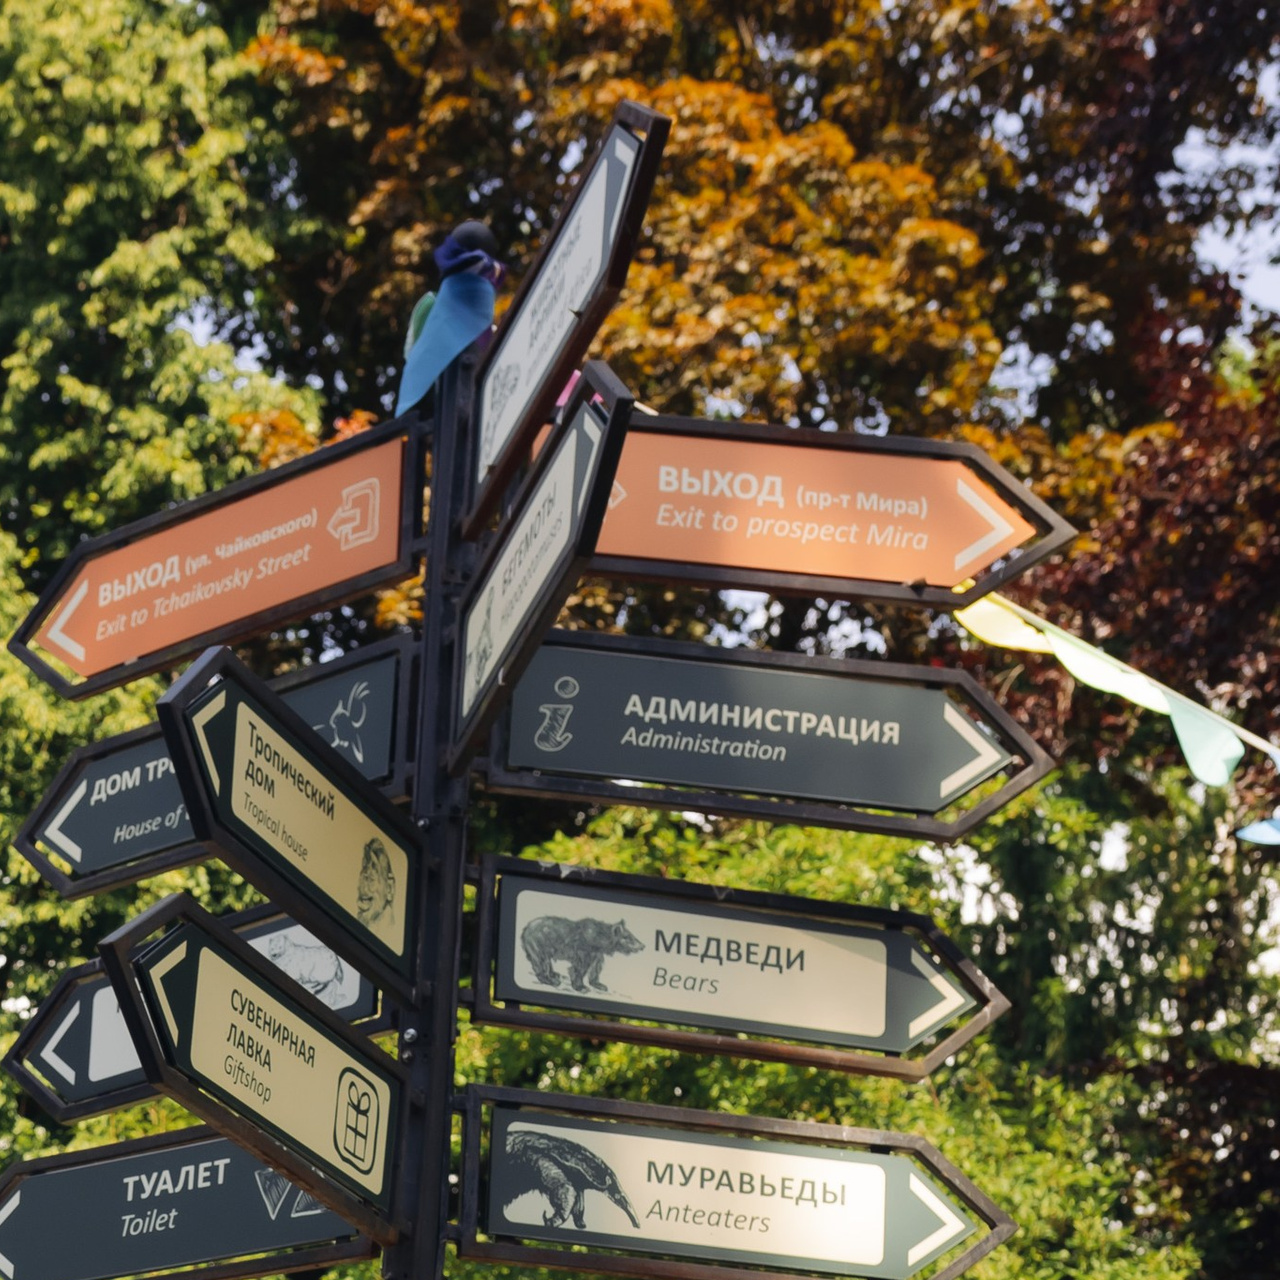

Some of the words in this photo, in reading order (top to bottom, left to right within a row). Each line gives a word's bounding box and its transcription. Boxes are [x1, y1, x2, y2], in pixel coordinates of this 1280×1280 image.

[658, 465, 785, 509] ВЫХОД
[795, 484, 851, 512] (пр-т
[856, 490, 928, 520] Мира)
[501, 481, 558, 598] БЕГЕМОТЫ
[656, 502, 705, 530] Exit
[712, 509, 739, 532] to
[746, 515, 860, 545] prospect
[865, 522, 929, 550] Mira
[98, 554, 181, 608] ВЫХОД
[184, 554, 212, 577] (ул.
[214, 507, 319, 561] Чайковского)
[95, 614, 127, 642] Exit
[130, 607, 149, 629] to
[152, 565, 254, 619] Tchaikovsky
[255, 543, 312, 581] Street
[621, 725, 787, 763] Administration
[623, 693, 901, 747] АДМИНИСТРАЦИЯ
[90, 766, 142, 806] ДОМ
[145, 757, 176, 782] ТР
[248, 720, 335, 821] Тропический
[113, 816, 162, 844] House
[164, 803, 184, 829] of
[244, 791, 280, 837] Tropical
[281, 824, 308, 862] house
[653, 928, 806, 973] МЕДВЕДИ
[652, 966, 721, 995] Bears
[226, 1023, 272, 1072] ЛАВКА
[231, 988, 315, 1068] СУВЕНИРНАЯ
[224, 1055, 272, 1105] Giftshop
[122, 1157, 231, 1203] ТУАЛЕТ
[646, 1160, 847, 1208] МУРАВЬЕДЫ
[120, 1207, 179, 1238] Toilet
[645, 1198, 771, 1234] Anteaters
